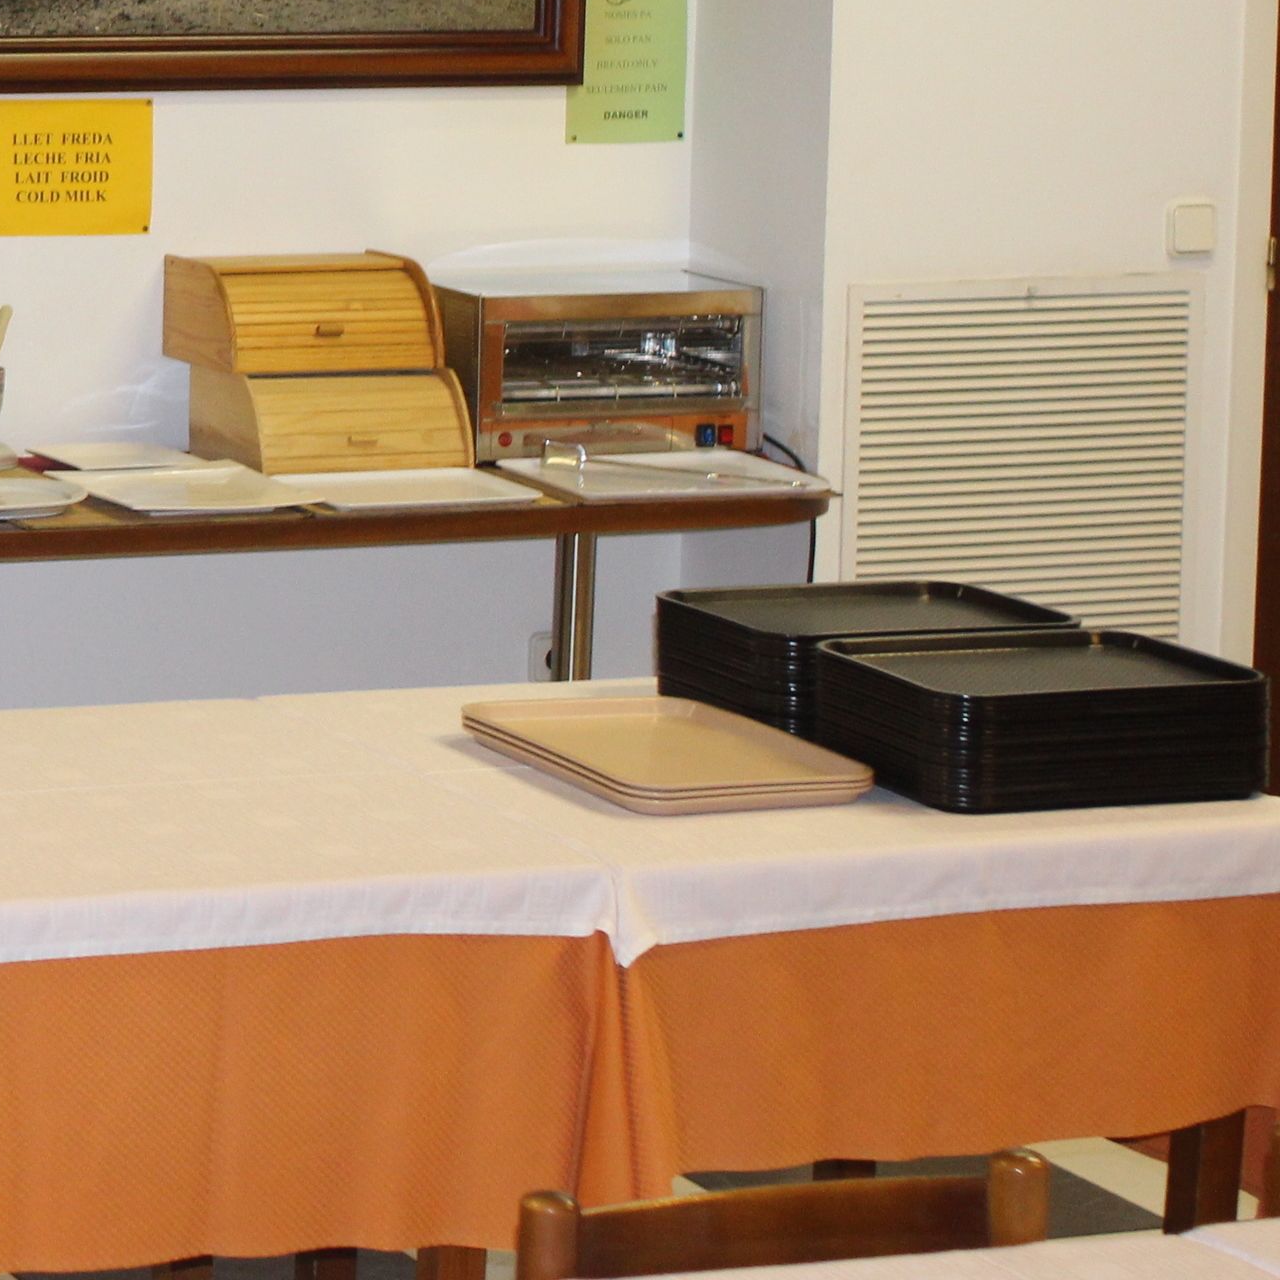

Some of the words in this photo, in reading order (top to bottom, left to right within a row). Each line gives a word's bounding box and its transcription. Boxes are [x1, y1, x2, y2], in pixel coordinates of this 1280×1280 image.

[603, 109, 649, 120] DANGER
[12, 133, 53, 145] LLET
[60, 132, 113, 145] FREDA
[13, 152, 67, 165] LECHE
[75, 152, 112, 164] FRIA
[15, 171, 52, 184] LAIT
[60, 171, 110, 183] FROID
[15, 190, 61, 203] COLD
[65, 190, 107, 202] MILK
